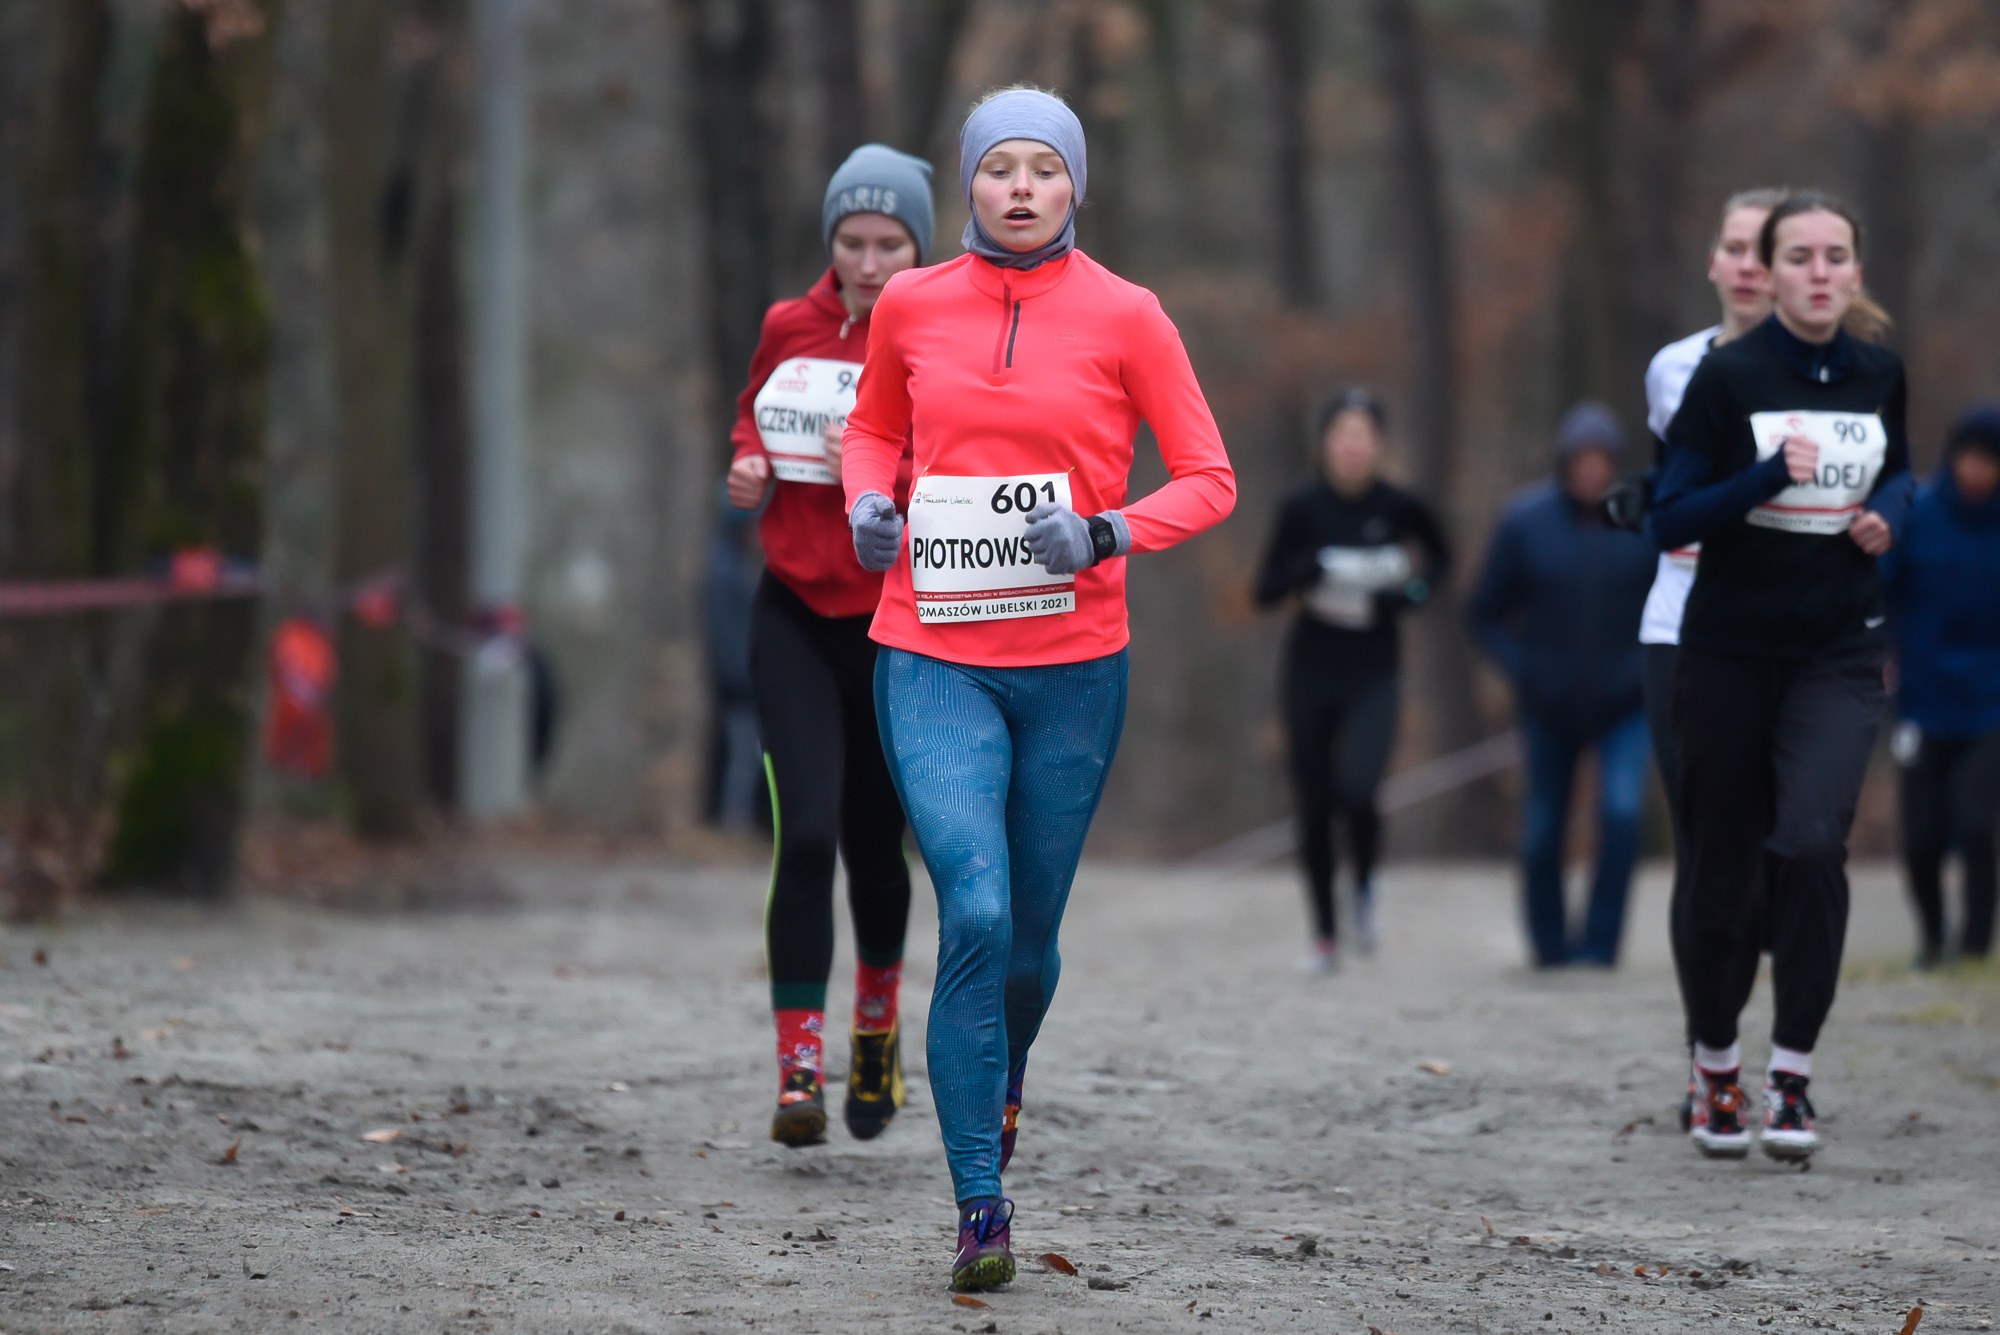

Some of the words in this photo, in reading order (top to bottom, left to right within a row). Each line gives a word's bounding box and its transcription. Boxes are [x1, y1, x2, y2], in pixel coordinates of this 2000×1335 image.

[838, 371, 856, 393] 9
[1834, 421, 1866, 444] 90
[991, 481, 1055, 514] 601
[913, 537, 1037, 569] PIOTROWS
[917, 603, 982, 617] OMASZÓW
[986, 600, 1037, 614] LUBELSKI
[1041, 597, 1067, 610] 2021
